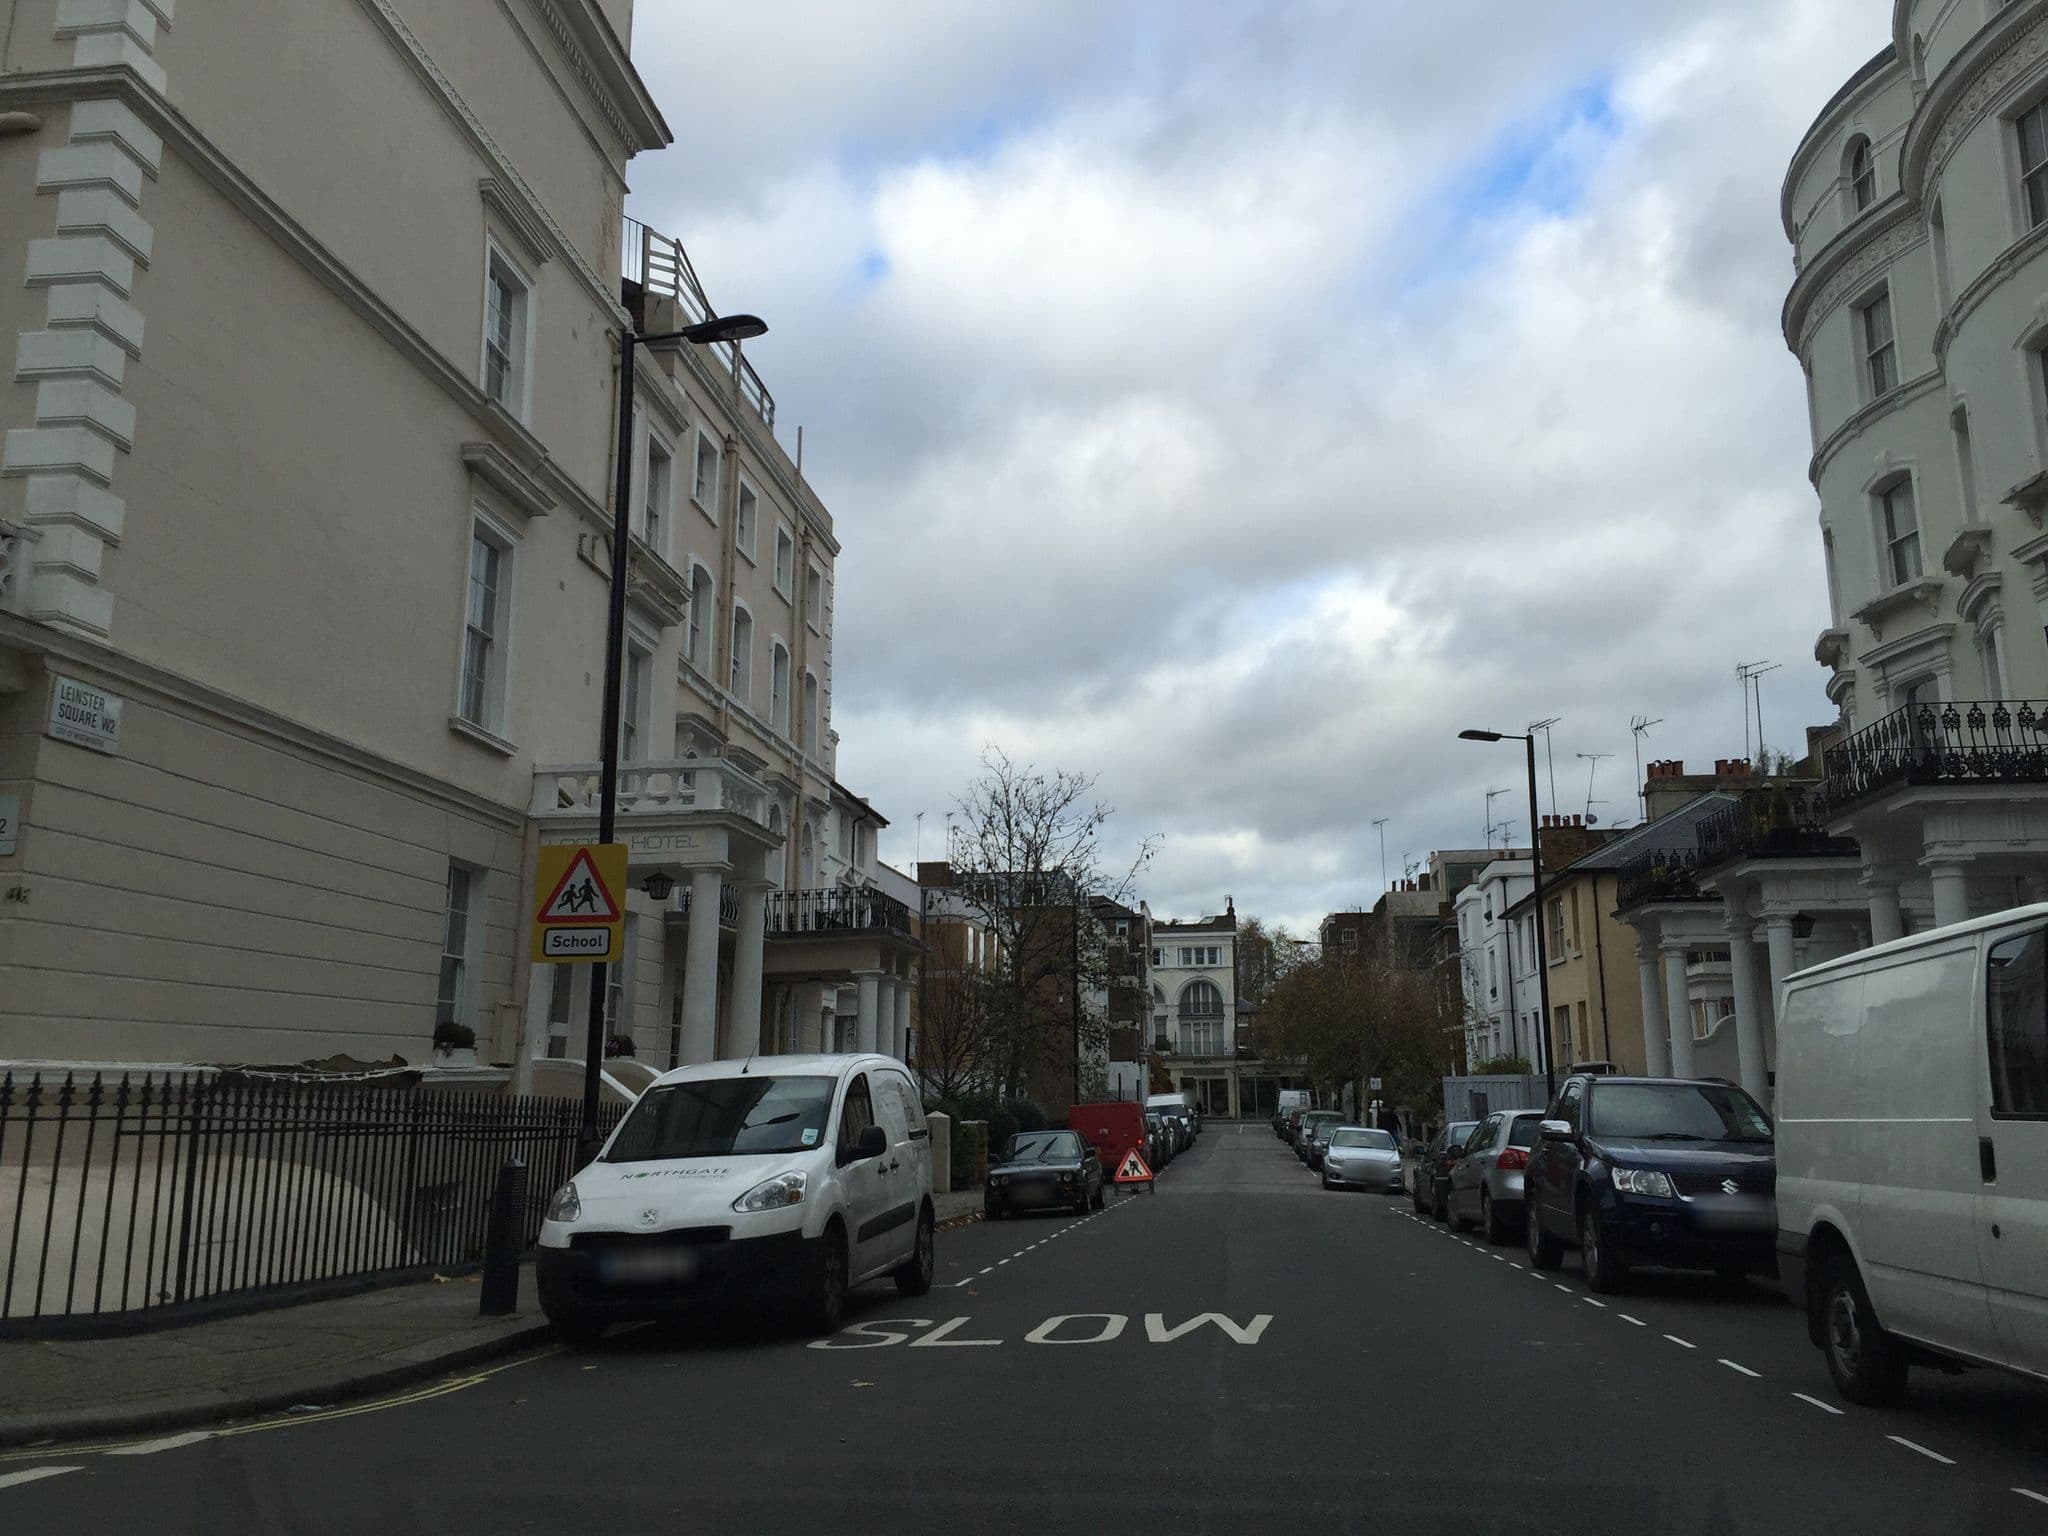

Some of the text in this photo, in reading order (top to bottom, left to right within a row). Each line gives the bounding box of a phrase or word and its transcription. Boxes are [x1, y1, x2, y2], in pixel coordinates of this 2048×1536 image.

[60, 684, 105, 712] LEINSTER
[58, 703, 116, 734] SQUARE W2
[631, 834, 700, 849] HOTEL
[552, 935, 603, 948] School
[620, 1167, 731, 1180] NORTHGATE
[806, 1313, 1274, 1349] SLOW
